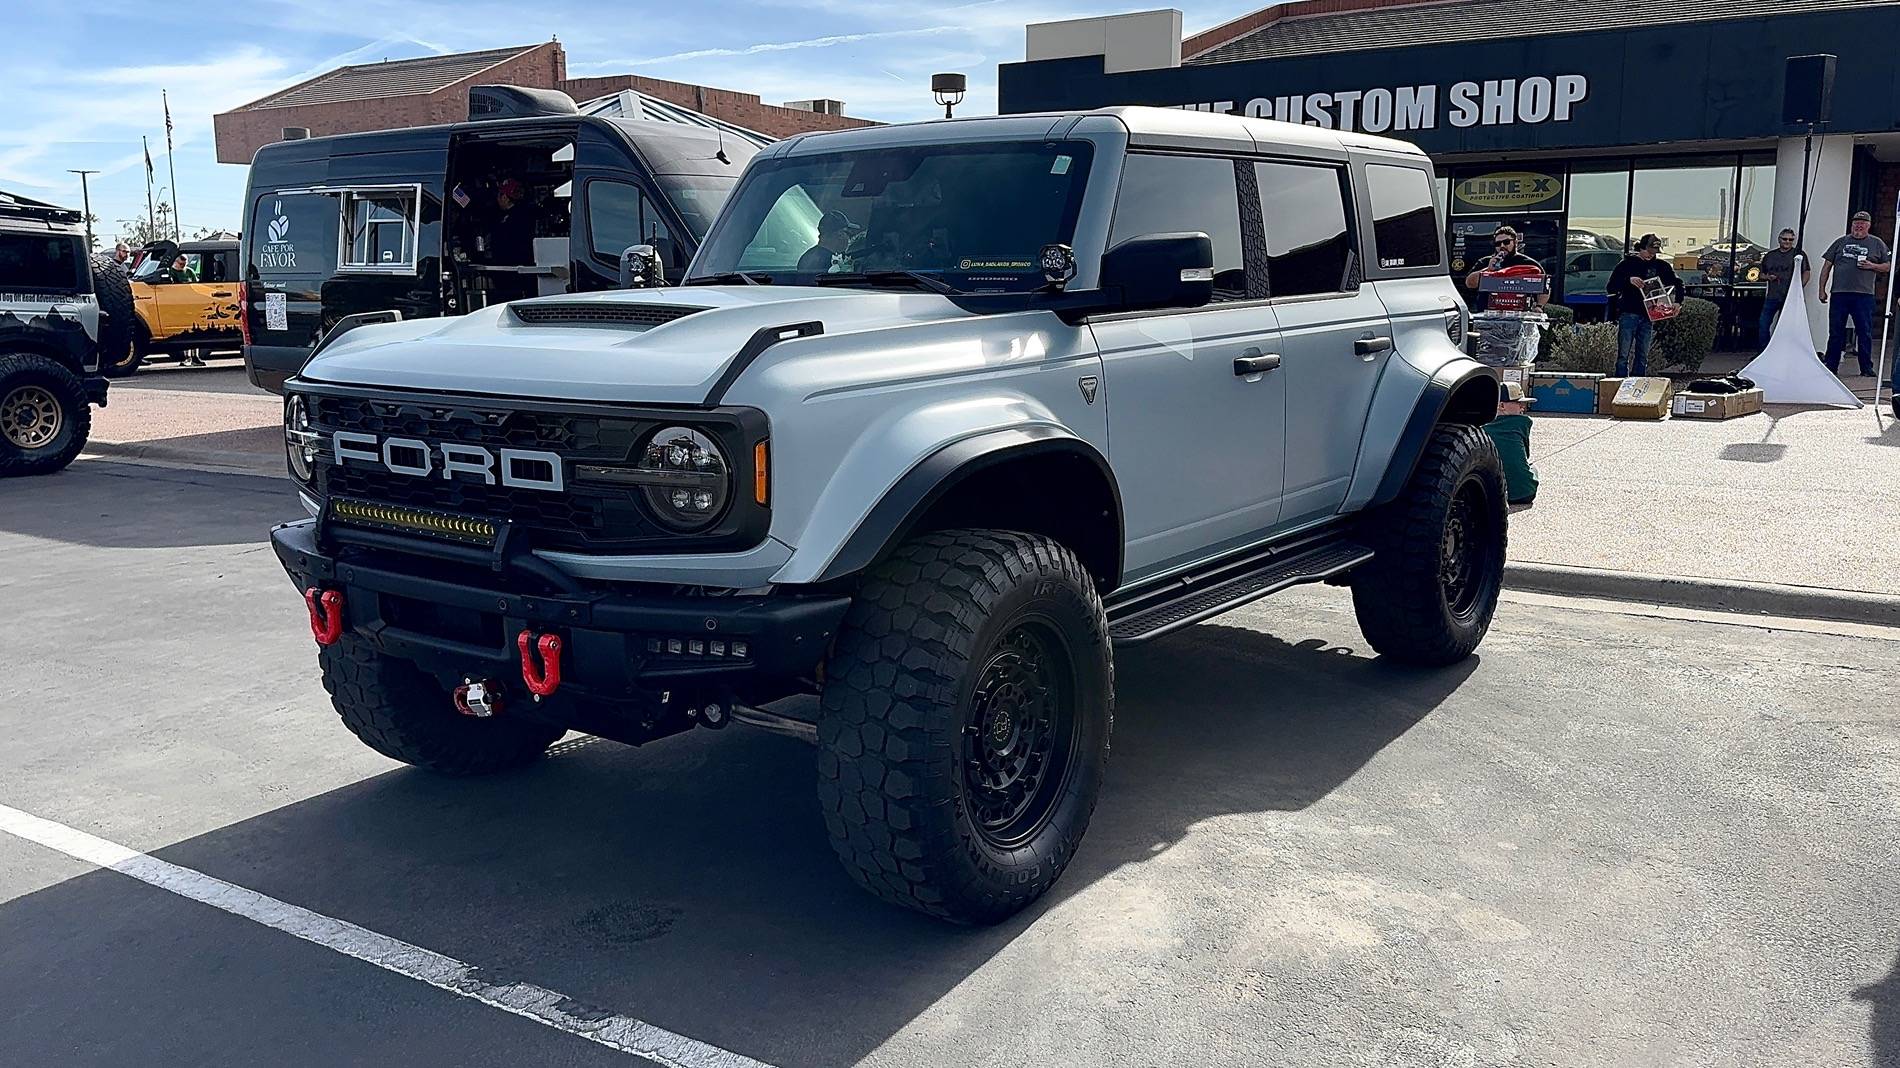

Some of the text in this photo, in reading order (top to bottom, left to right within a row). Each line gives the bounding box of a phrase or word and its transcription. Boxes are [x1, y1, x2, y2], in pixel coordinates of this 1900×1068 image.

[1449, 75, 1587, 128] SHOP
[1464, 179, 1551, 195] LINE-X
[262, 243, 294, 253] CAFE POR
[260, 252, 297, 268] FAVOR
[333, 430, 564, 492] FORD
